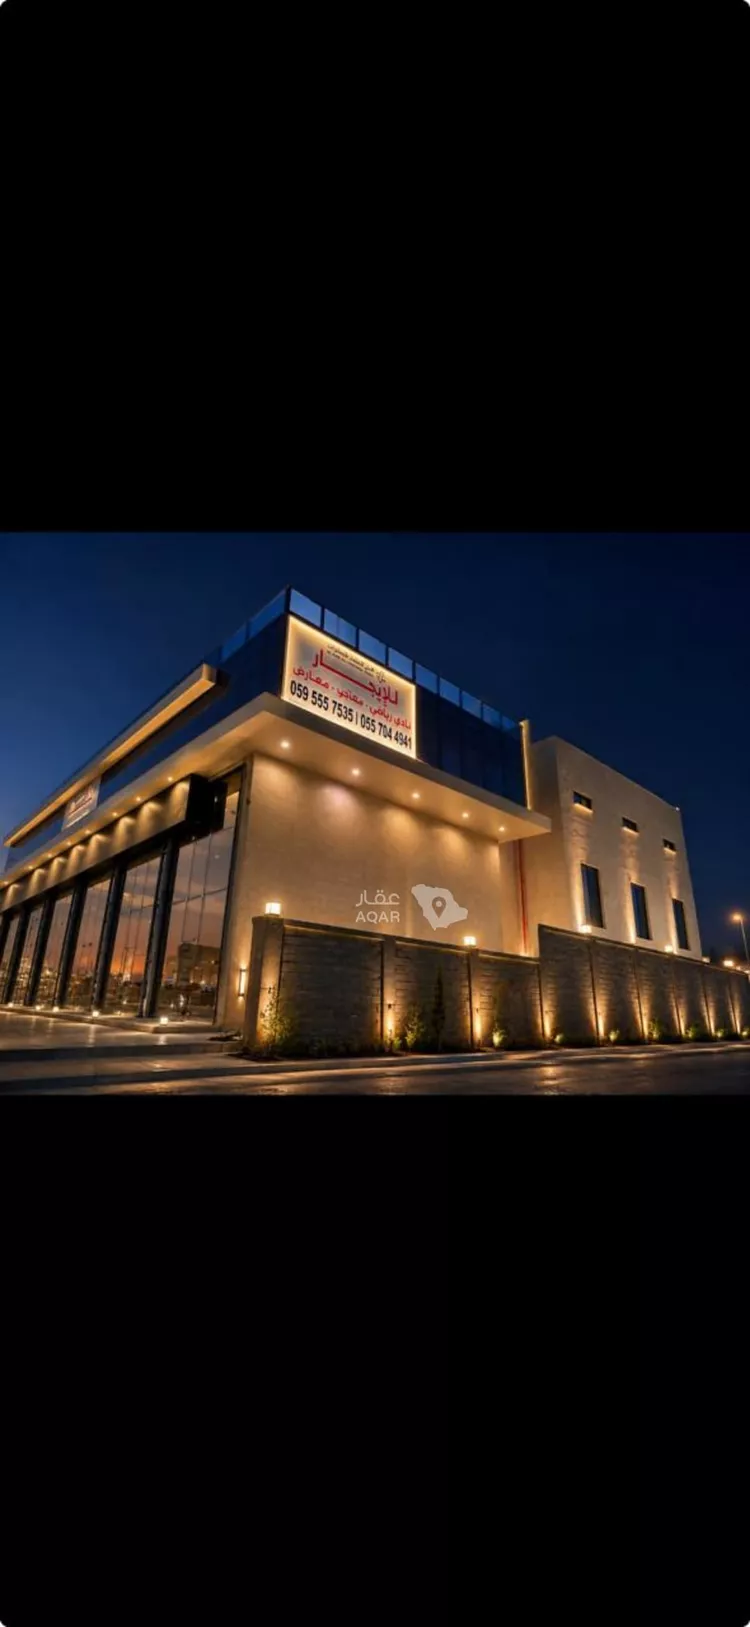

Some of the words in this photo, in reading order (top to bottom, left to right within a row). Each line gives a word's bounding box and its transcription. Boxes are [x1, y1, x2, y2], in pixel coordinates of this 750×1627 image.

[290, 680, 308, 701] 059
[311, 691, 329, 711] 555
[332, 700, 353, 722] 7535
[361, 714, 376, 733] 055
[378, 722, 392, 739] 704
[394, 731, 412, 749] 4941
